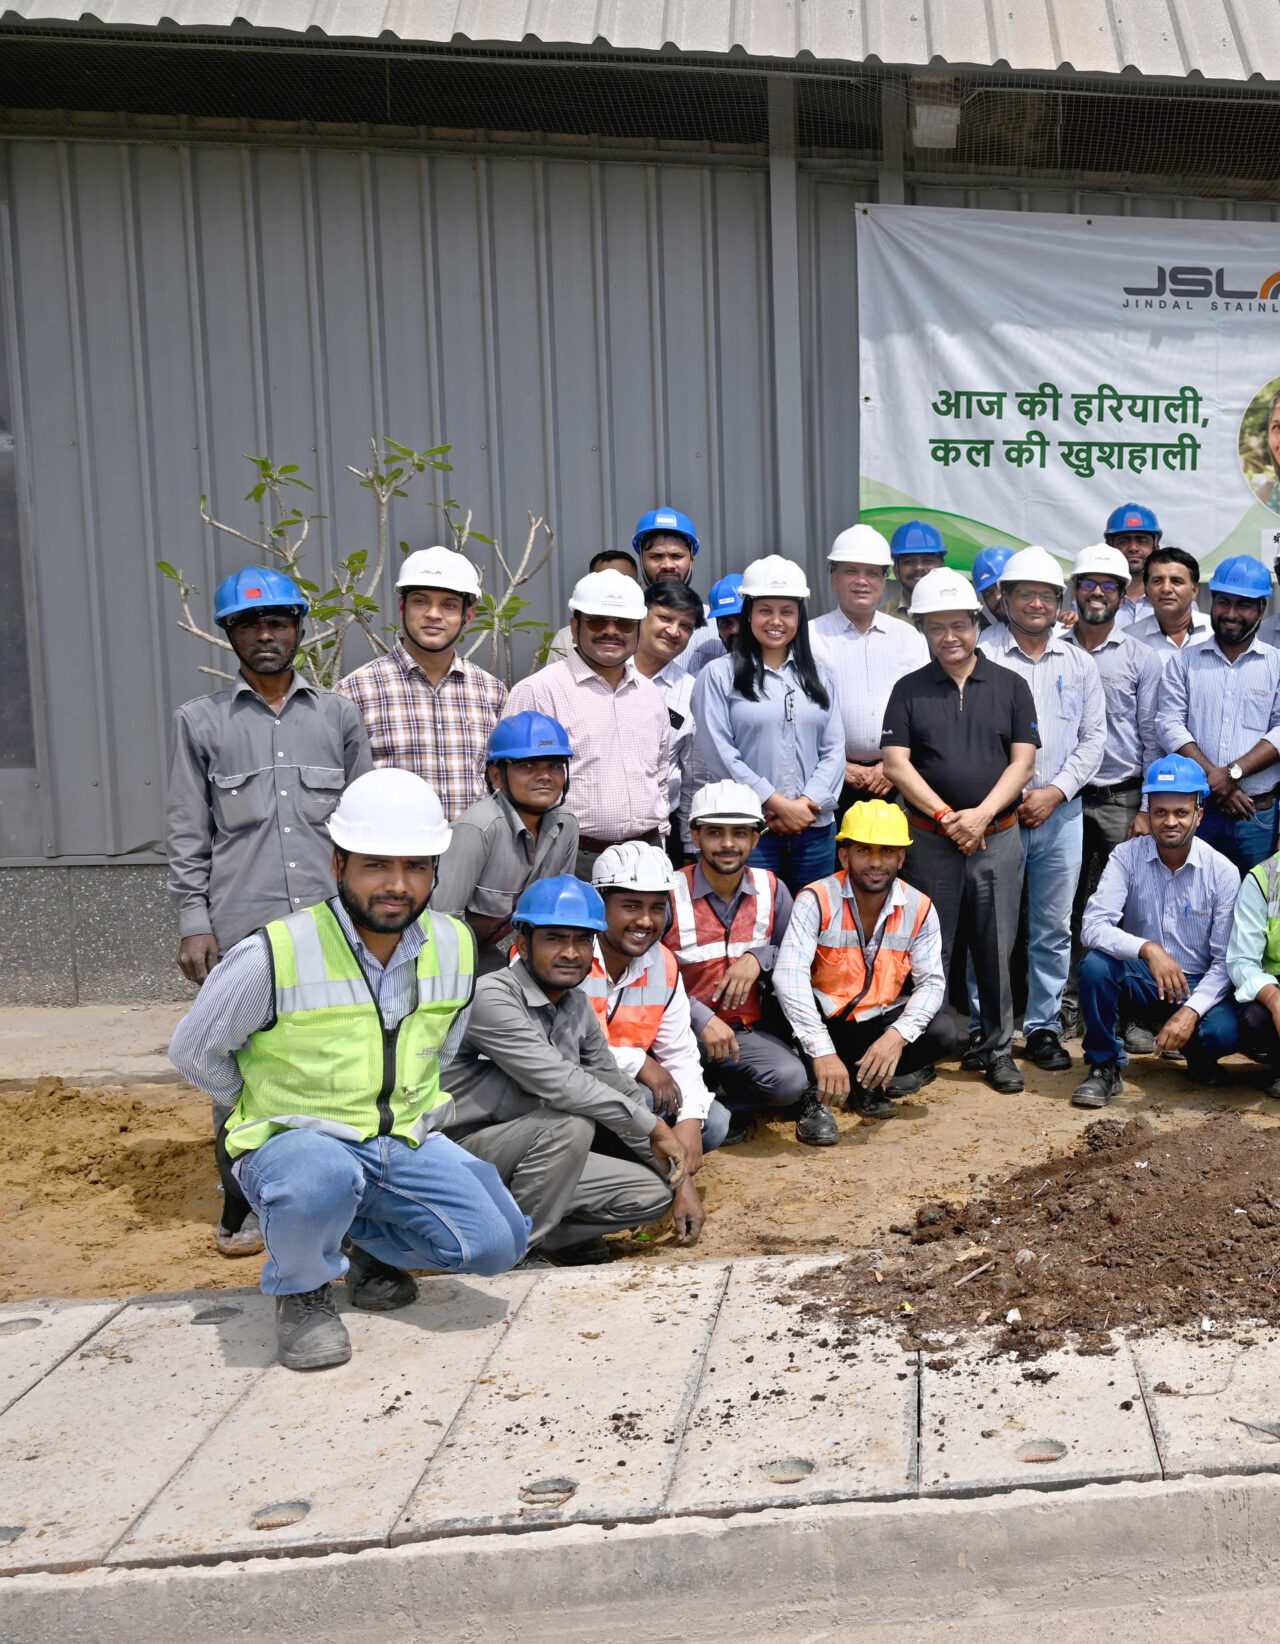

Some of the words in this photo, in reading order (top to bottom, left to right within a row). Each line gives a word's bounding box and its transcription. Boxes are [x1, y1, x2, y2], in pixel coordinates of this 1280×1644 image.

[1122, 299, 1193, 310] JINDAL
[932, 390, 1007, 420] आज
[1015, 382, 1062, 421] की
[1071, 384, 1209, 428] हरियाली,
[929, 439, 994, 467] कल
[1002, 430, 1050, 468] की
[1058, 433, 1201, 478] खुशहाली
